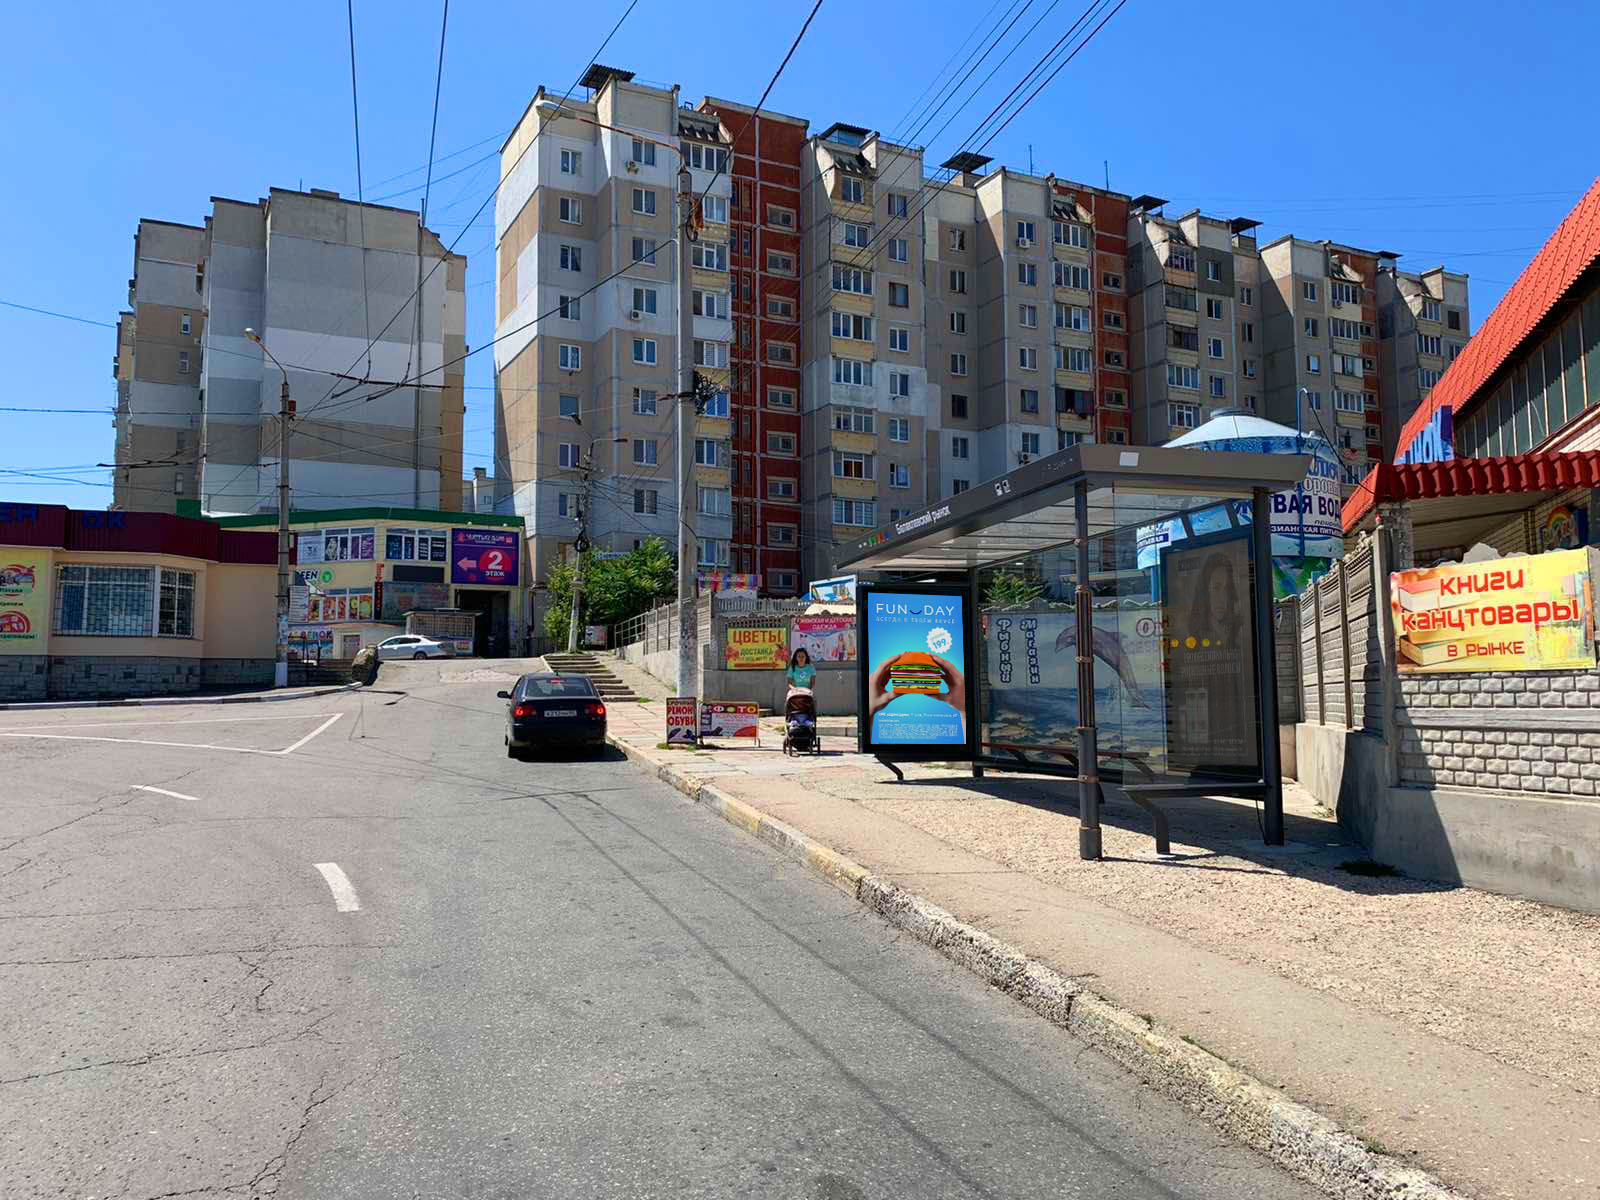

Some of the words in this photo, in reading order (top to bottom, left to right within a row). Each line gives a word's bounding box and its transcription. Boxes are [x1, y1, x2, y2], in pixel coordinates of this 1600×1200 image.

[487, 551, 503, 570] 2
[876, 603, 908, 615] FUN
[924, 605, 955, 616] DAY
[733, 629, 785, 645] ЦВЕТЫ
[932, 638, 947, 650] 199
[1447, 644, 1458, 657] В
[1466, 641, 1525, 657] РЫНКЕ
[713, 705, 757, 714] ФОТО
[667, 716, 696, 726] ОБУВИ
